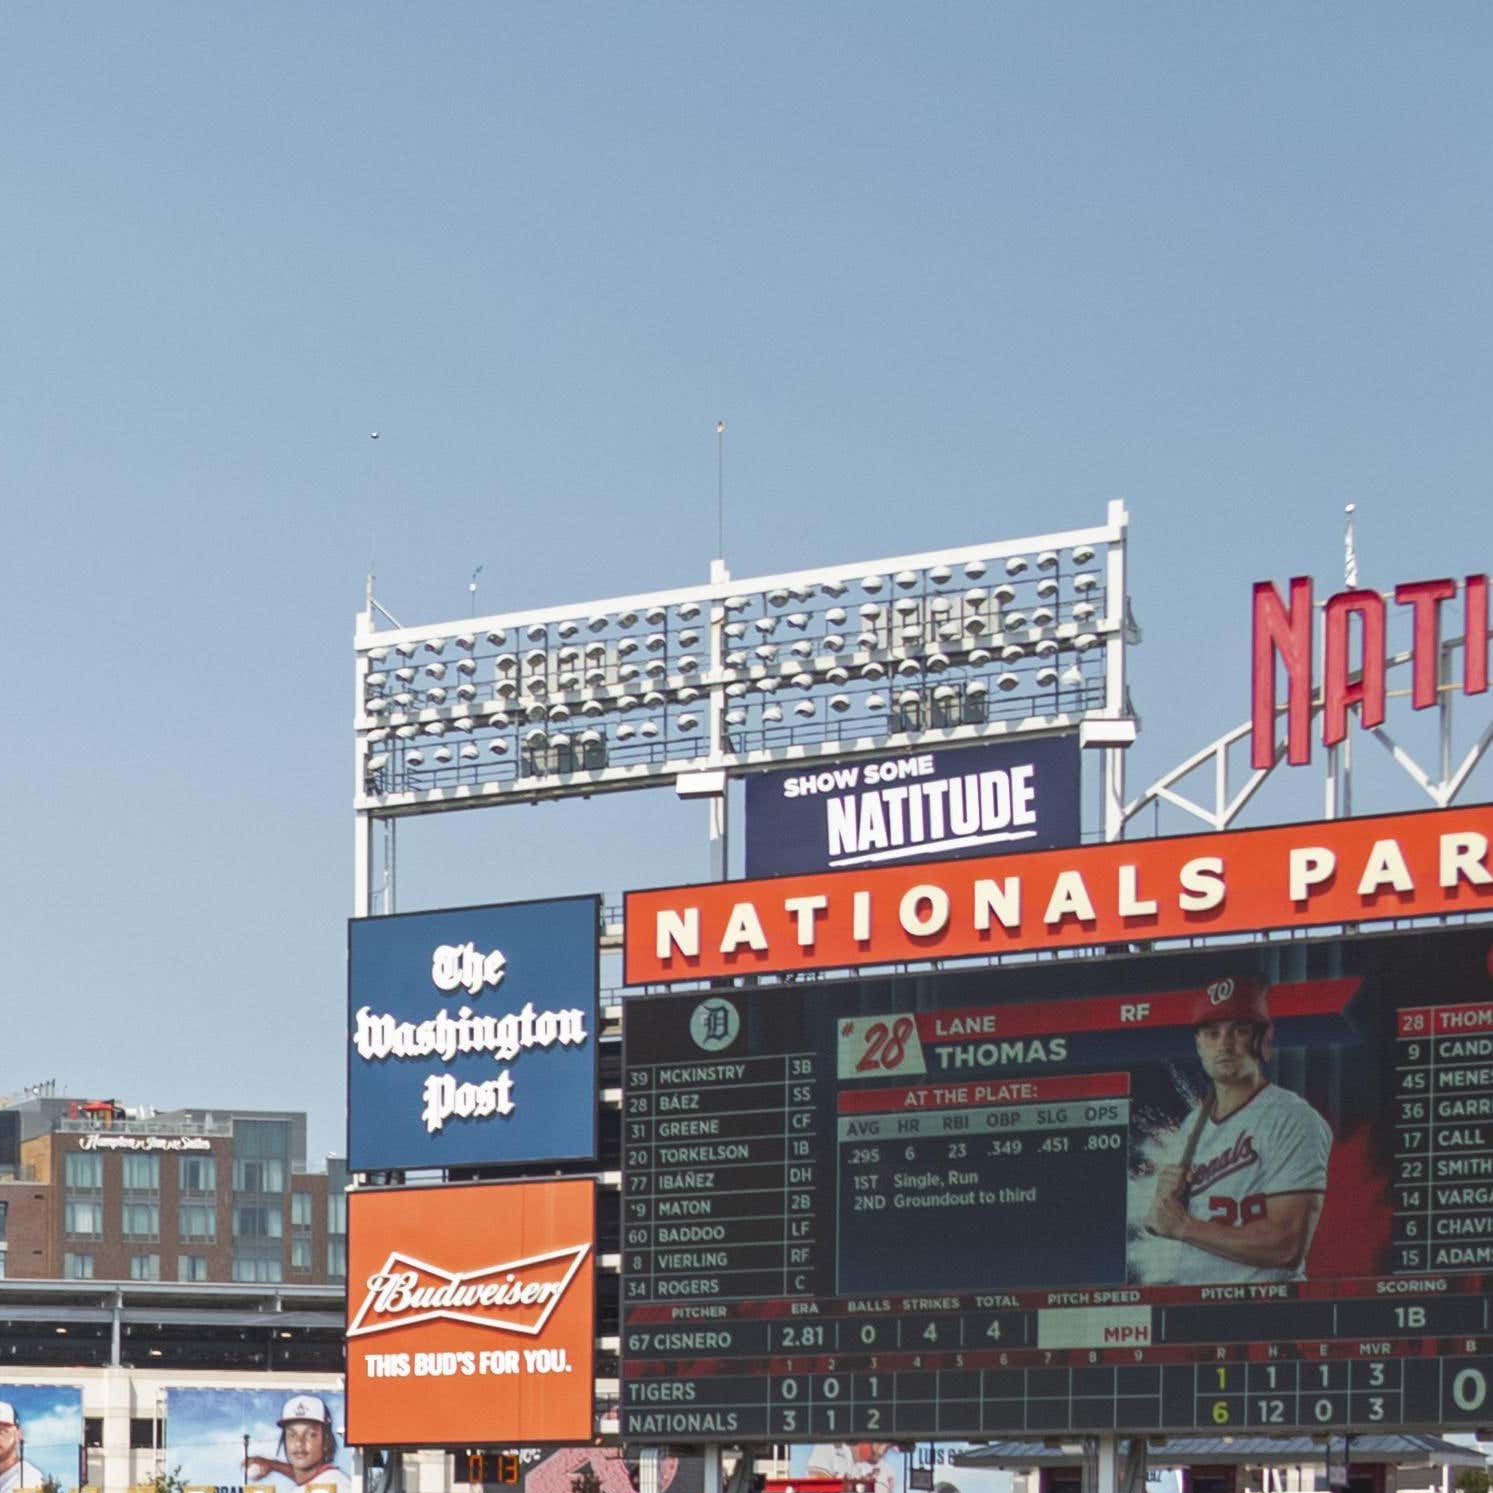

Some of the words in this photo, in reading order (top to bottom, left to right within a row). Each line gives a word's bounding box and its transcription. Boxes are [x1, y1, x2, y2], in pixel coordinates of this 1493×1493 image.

[783, 769, 858, 798] SHOW
[863, 754, 934, 787] SOME
[827, 763, 1036, 857] NATITUDE
[656, 857, 1227, 959] NATIONALS
[432, 942, 506, 995] The
[353, 1002, 588, 1061] Washington
[936, 1016, 996, 1036] LANE
[1120, 1003, 1150, 1022] RF
[935, 1038, 1068, 1071] THOMAS
[660, 1065, 745, 1084] MCKINSTRY
[792, 1060, 812, 1075] 3B
[422, 1069, 516, 1134] Post
[905, 1090, 929, 1107] AT
[934, 1087, 969, 1105] THE
[975, 1083, 1038, 1102] PLATE:
[659, 1120, 719, 1138] GREENE
[846, 1120, 881, 1137] AVG
[942, 1116, 969, 1132] RBI
[986, 1112, 1021, 1129] OBP
[1037, 1109, 1068, 1125] SLG
[1084, 1105, 1119, 1122] OPS
[1438, 1129, 1485, 1145] CALL
[660, 1145, 749, 1164] TORKELSON
[948, 1144, 968, 1159] 23
[790, 1168, 812, 1182] DH
[948, 1171, 978, 1187] Run
[659, 1200, 712, 1216] MATON
[853, 1195, 886, 1211] 2ND
[893, 1190, 975, 1209] Groundout
[999, 1187, 1036, 1203] third
[659, 1227, 726, 1243] BADDOO
[658, 1253, 728, 1269] VIERLING
[366, 1272, 565, 1314] Budweiser
[658, 1280, 720, 1296] ROGERS
[1104, 1326, 1149, 1343] MPH
[1394, 1307, 1426, 1329] 1B
[653, 1333, 732, 1350] CISNERO
[782, 1327, 824, 1346] 2.81
[365, 1353, 411, 1378] THIS
[414, 1351, 475, 1377] BUD'S
[479, 1350, 520, 1375] FOR
[523, 1348, 573, 1374] YOU.
[629, 1383, 696, 1401] TIGERS
[628, 1412, 738, 1433] NATIONALS
